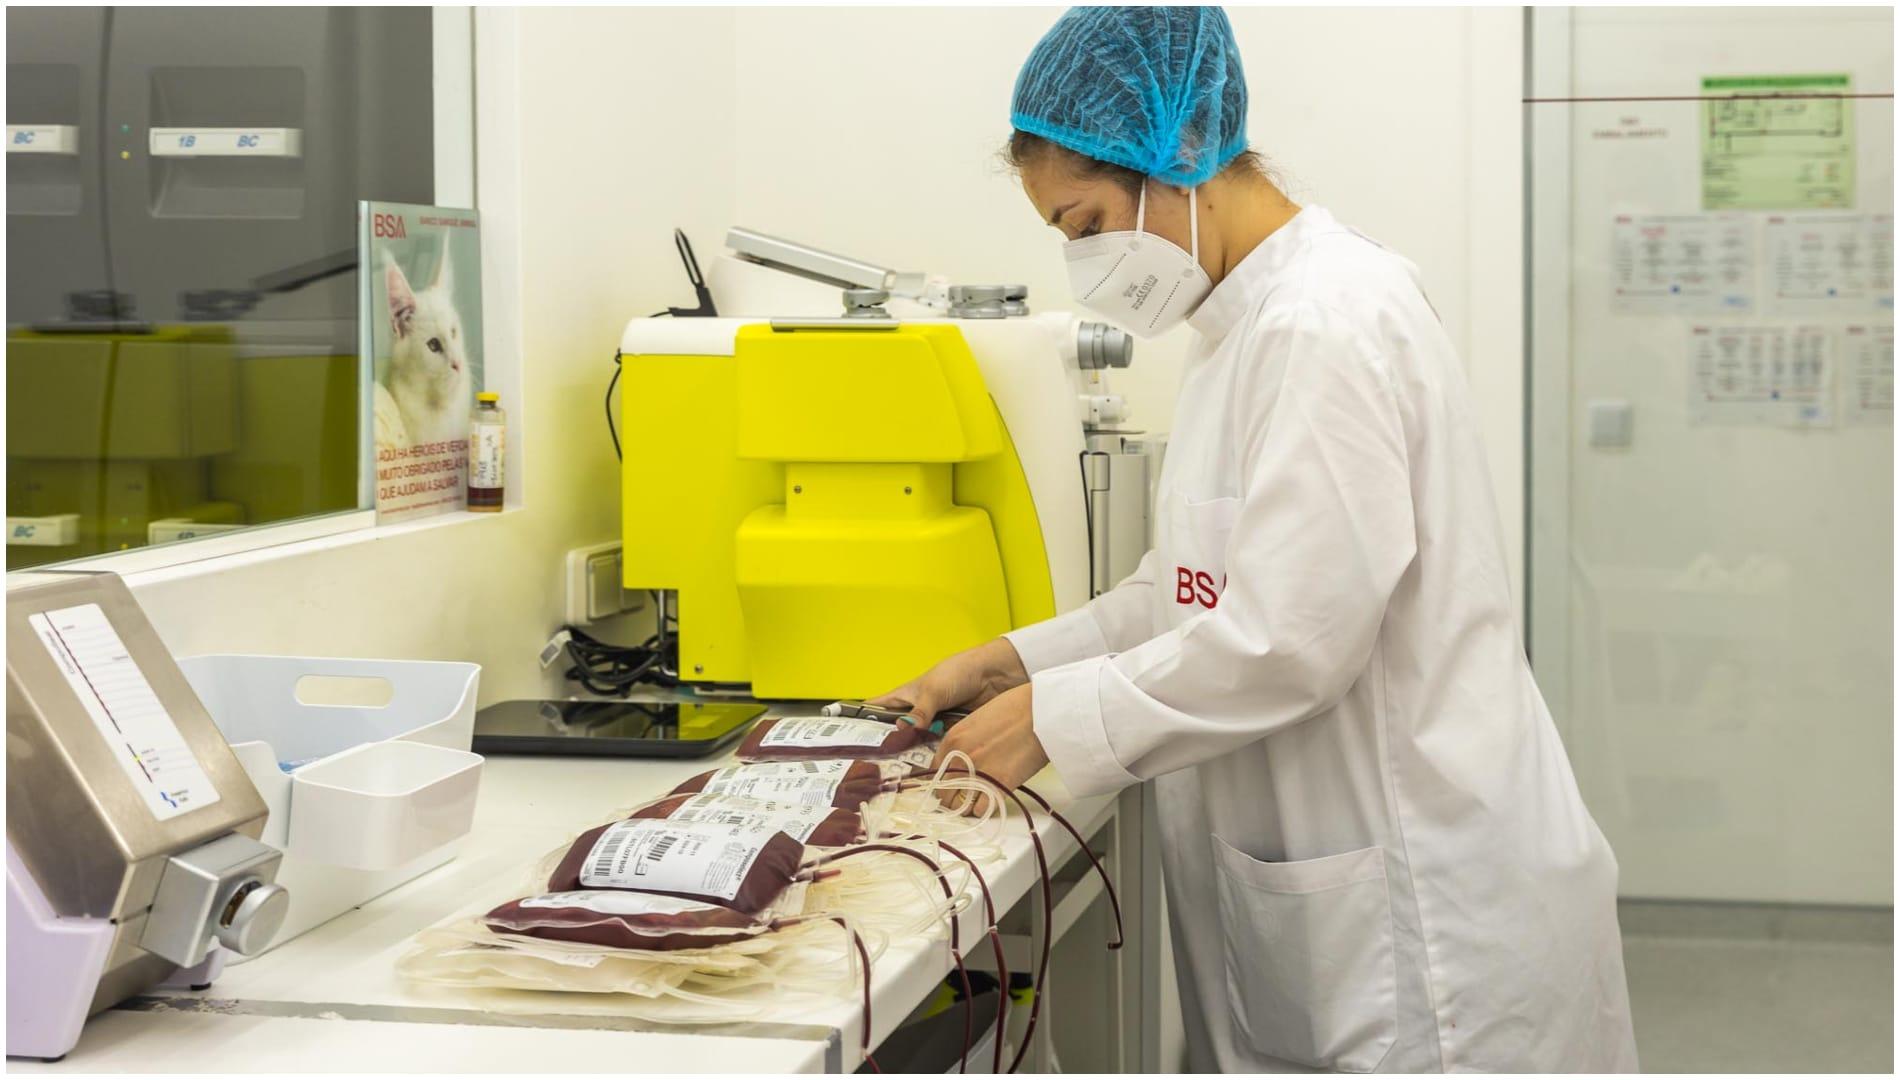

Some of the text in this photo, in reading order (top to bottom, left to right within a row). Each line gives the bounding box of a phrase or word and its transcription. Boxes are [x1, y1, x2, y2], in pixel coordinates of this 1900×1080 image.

[13, 131, 36, 144] BC
[178, 135, 260, 148] 1B BC
[374, 213, 407, 239] BSA
[13, 525, 36, 538] BC
[1176, 566, 1227, 609] BS
